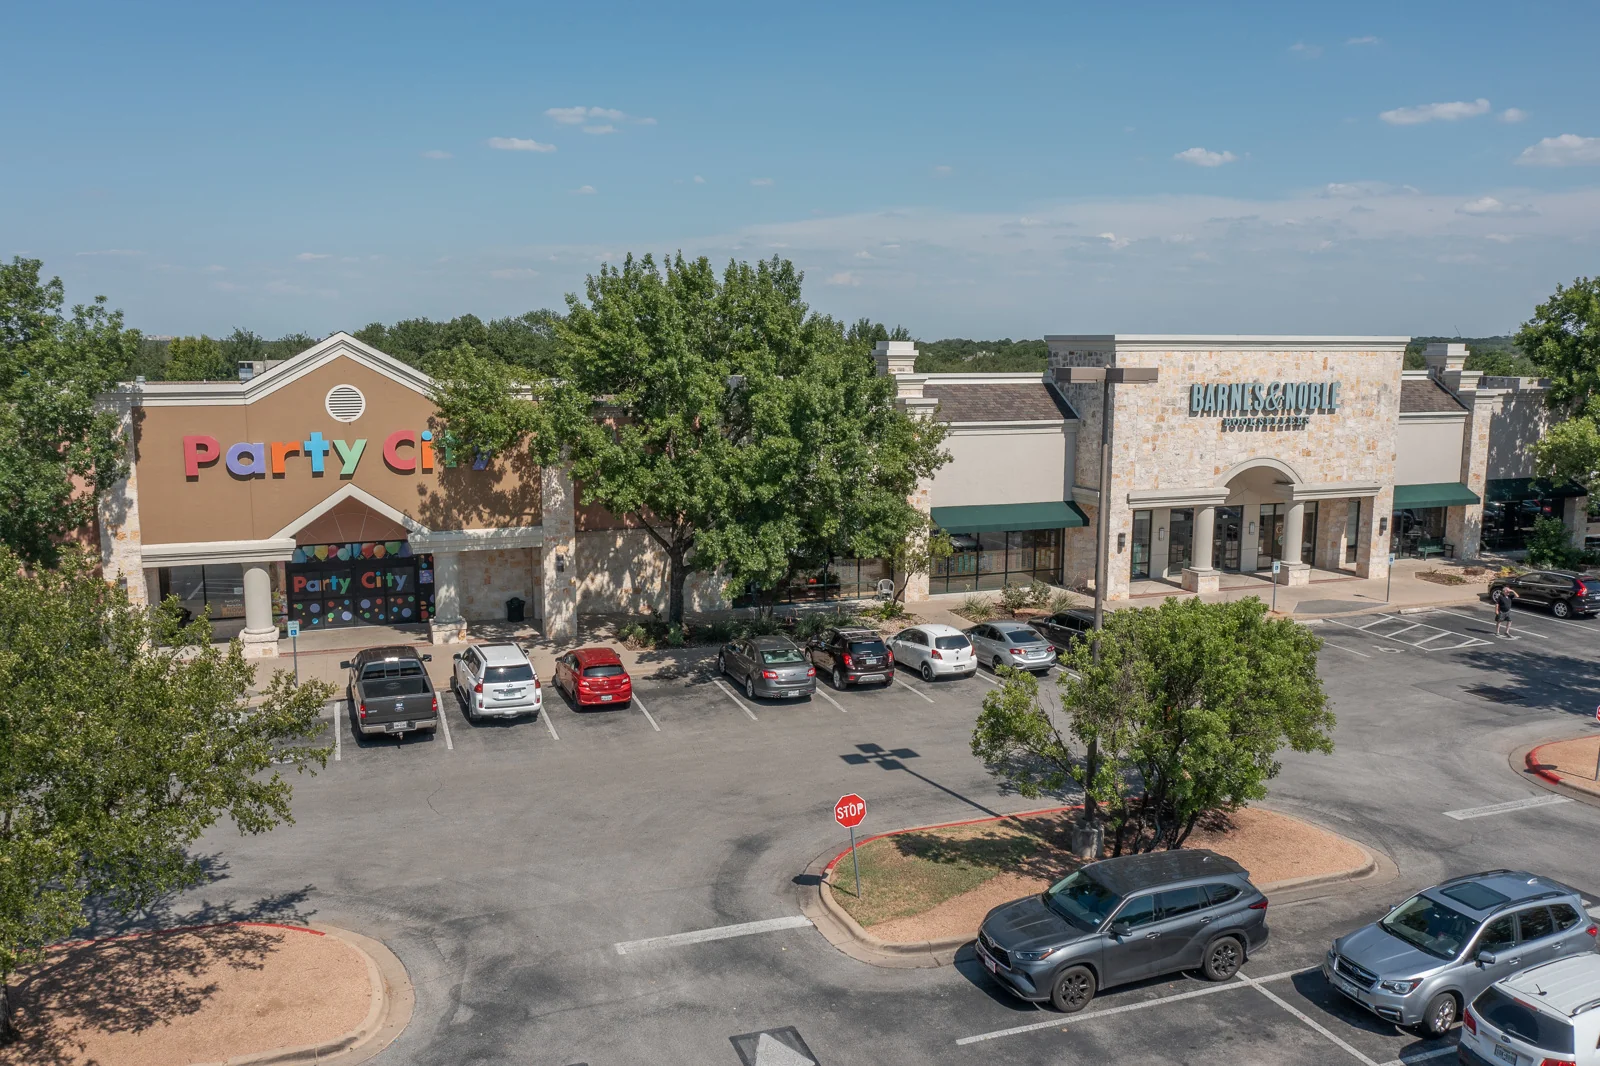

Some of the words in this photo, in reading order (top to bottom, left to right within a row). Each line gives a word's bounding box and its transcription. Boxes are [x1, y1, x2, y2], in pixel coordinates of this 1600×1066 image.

[1223, 415, 1310, 428] BOOKSELLERS
[183, 431, 368, 477] Party
[293, 575, 352, 595] Party
[361, 571, 408, 591] City
[837, 802, 864, 819] STOP
